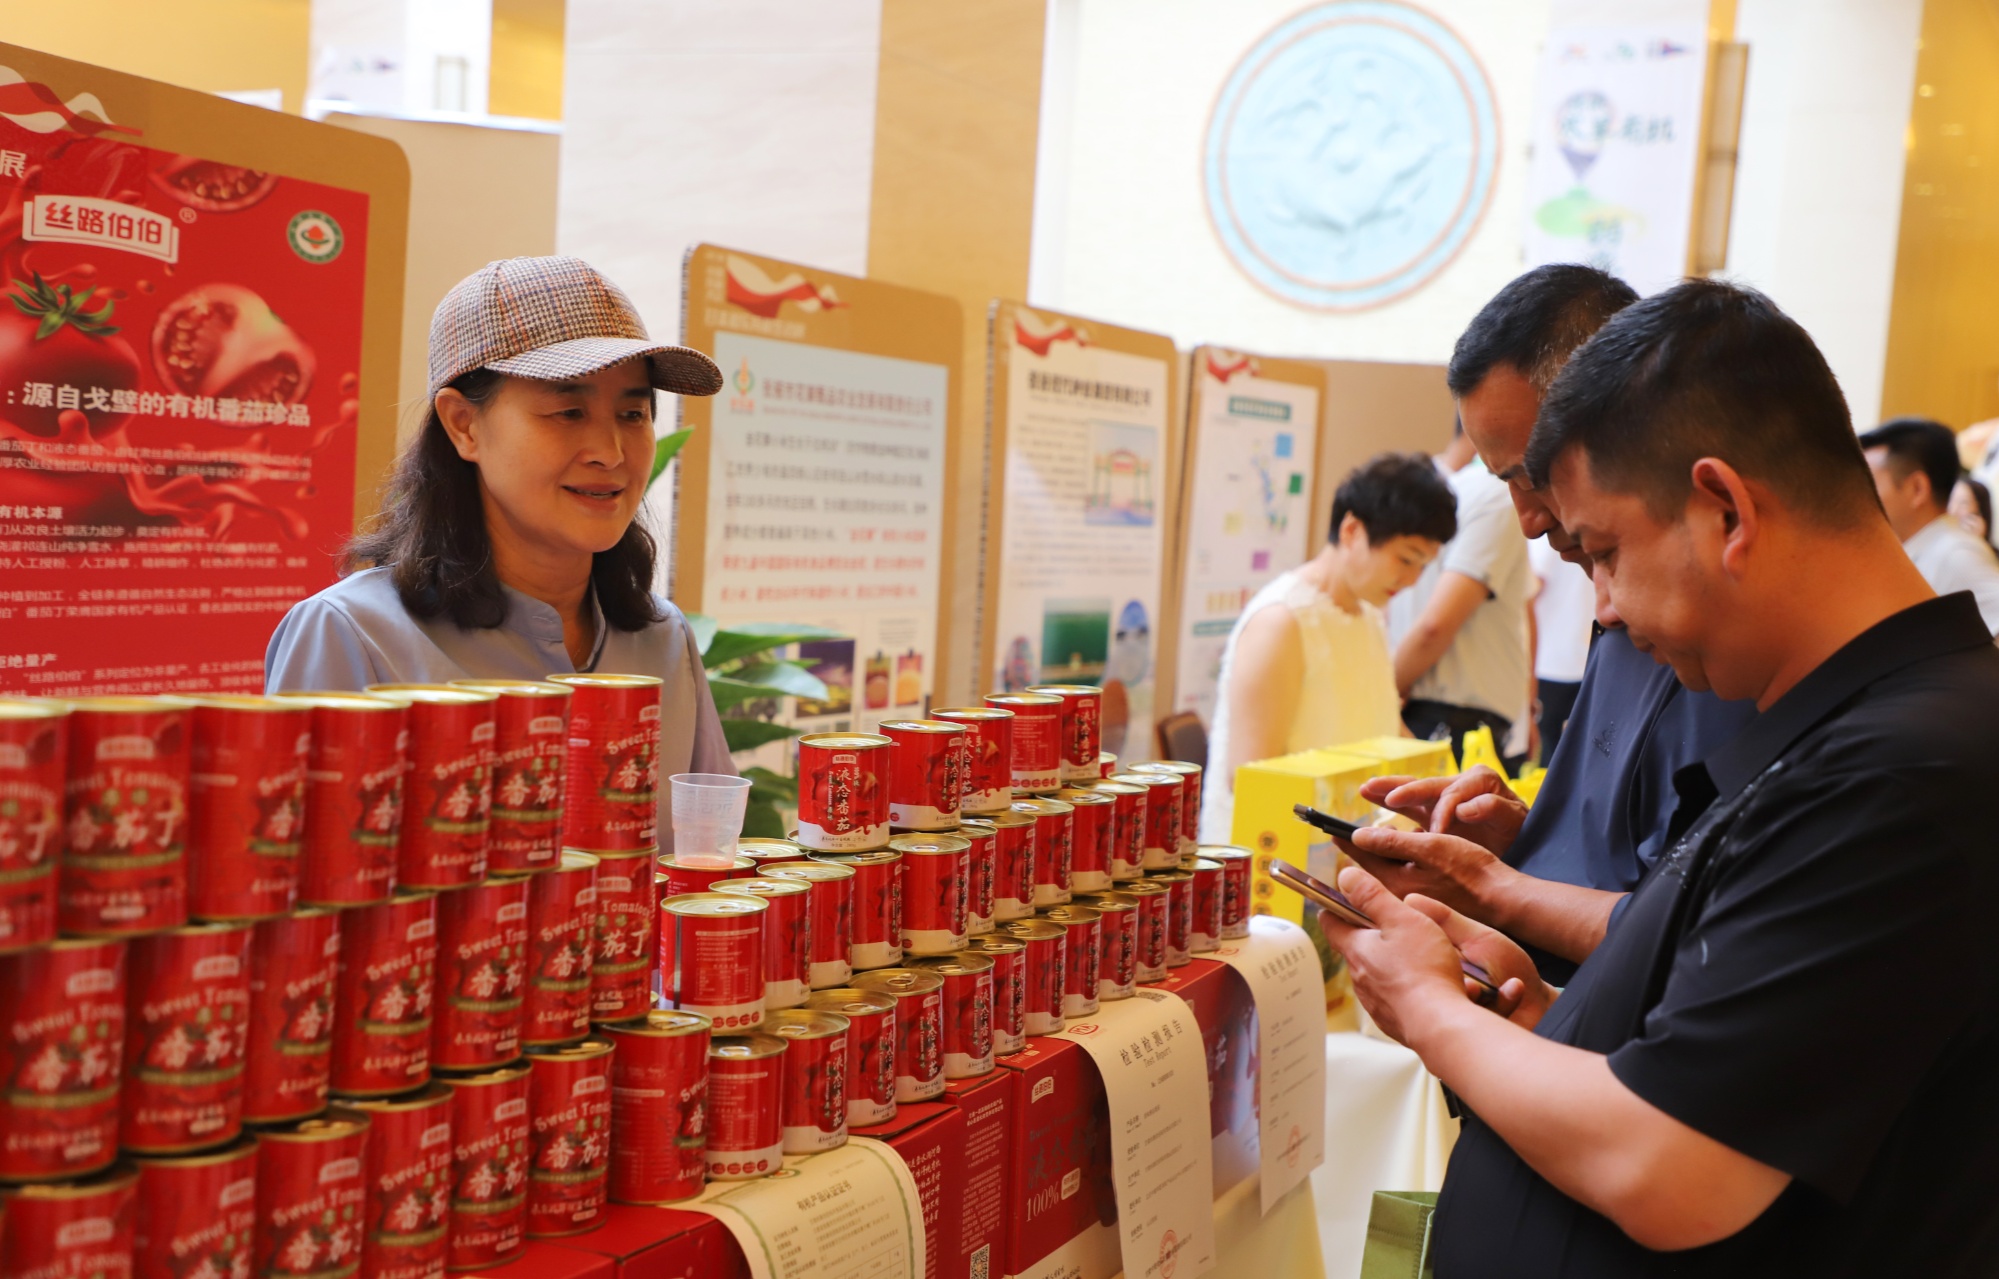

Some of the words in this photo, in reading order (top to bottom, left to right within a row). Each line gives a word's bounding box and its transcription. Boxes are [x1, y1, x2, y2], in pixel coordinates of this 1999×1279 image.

[0, 151, 25, 179] 展
[44, 201, 162, 245] 丝路伯伯
[606, 731, 641, 755] Sweet
[948, 750, 960, 812] 液态番茄
[835, 767, 852, 832] 液态番茄
[601, 899, 652, 919] Tomatoes
[541, 920, 579, 942] Sweet
[603, 927, 648, 961] 茄丁
[457, 936, 503, 960] Sweet
[926, 1010, 938, 1078] 液态番茄
[1119, 1019, 1182, 1066] 检验检测报告
[1143, 1057, 1155, 1067] Test
[1155, 1047, 1172, 1061] Report
[832, 1054, 843, 1128] 液态番茄
[1034, 1078, 1052, 1096] 丝路伯伯
[534, 1108, 578, 1132] Sweet
[453, 1132, 499, 1162] Sweet
[796, 1180, 852, 1211] 有机产品认证证书
[1026, 1180, 1059, 1222] 100%
